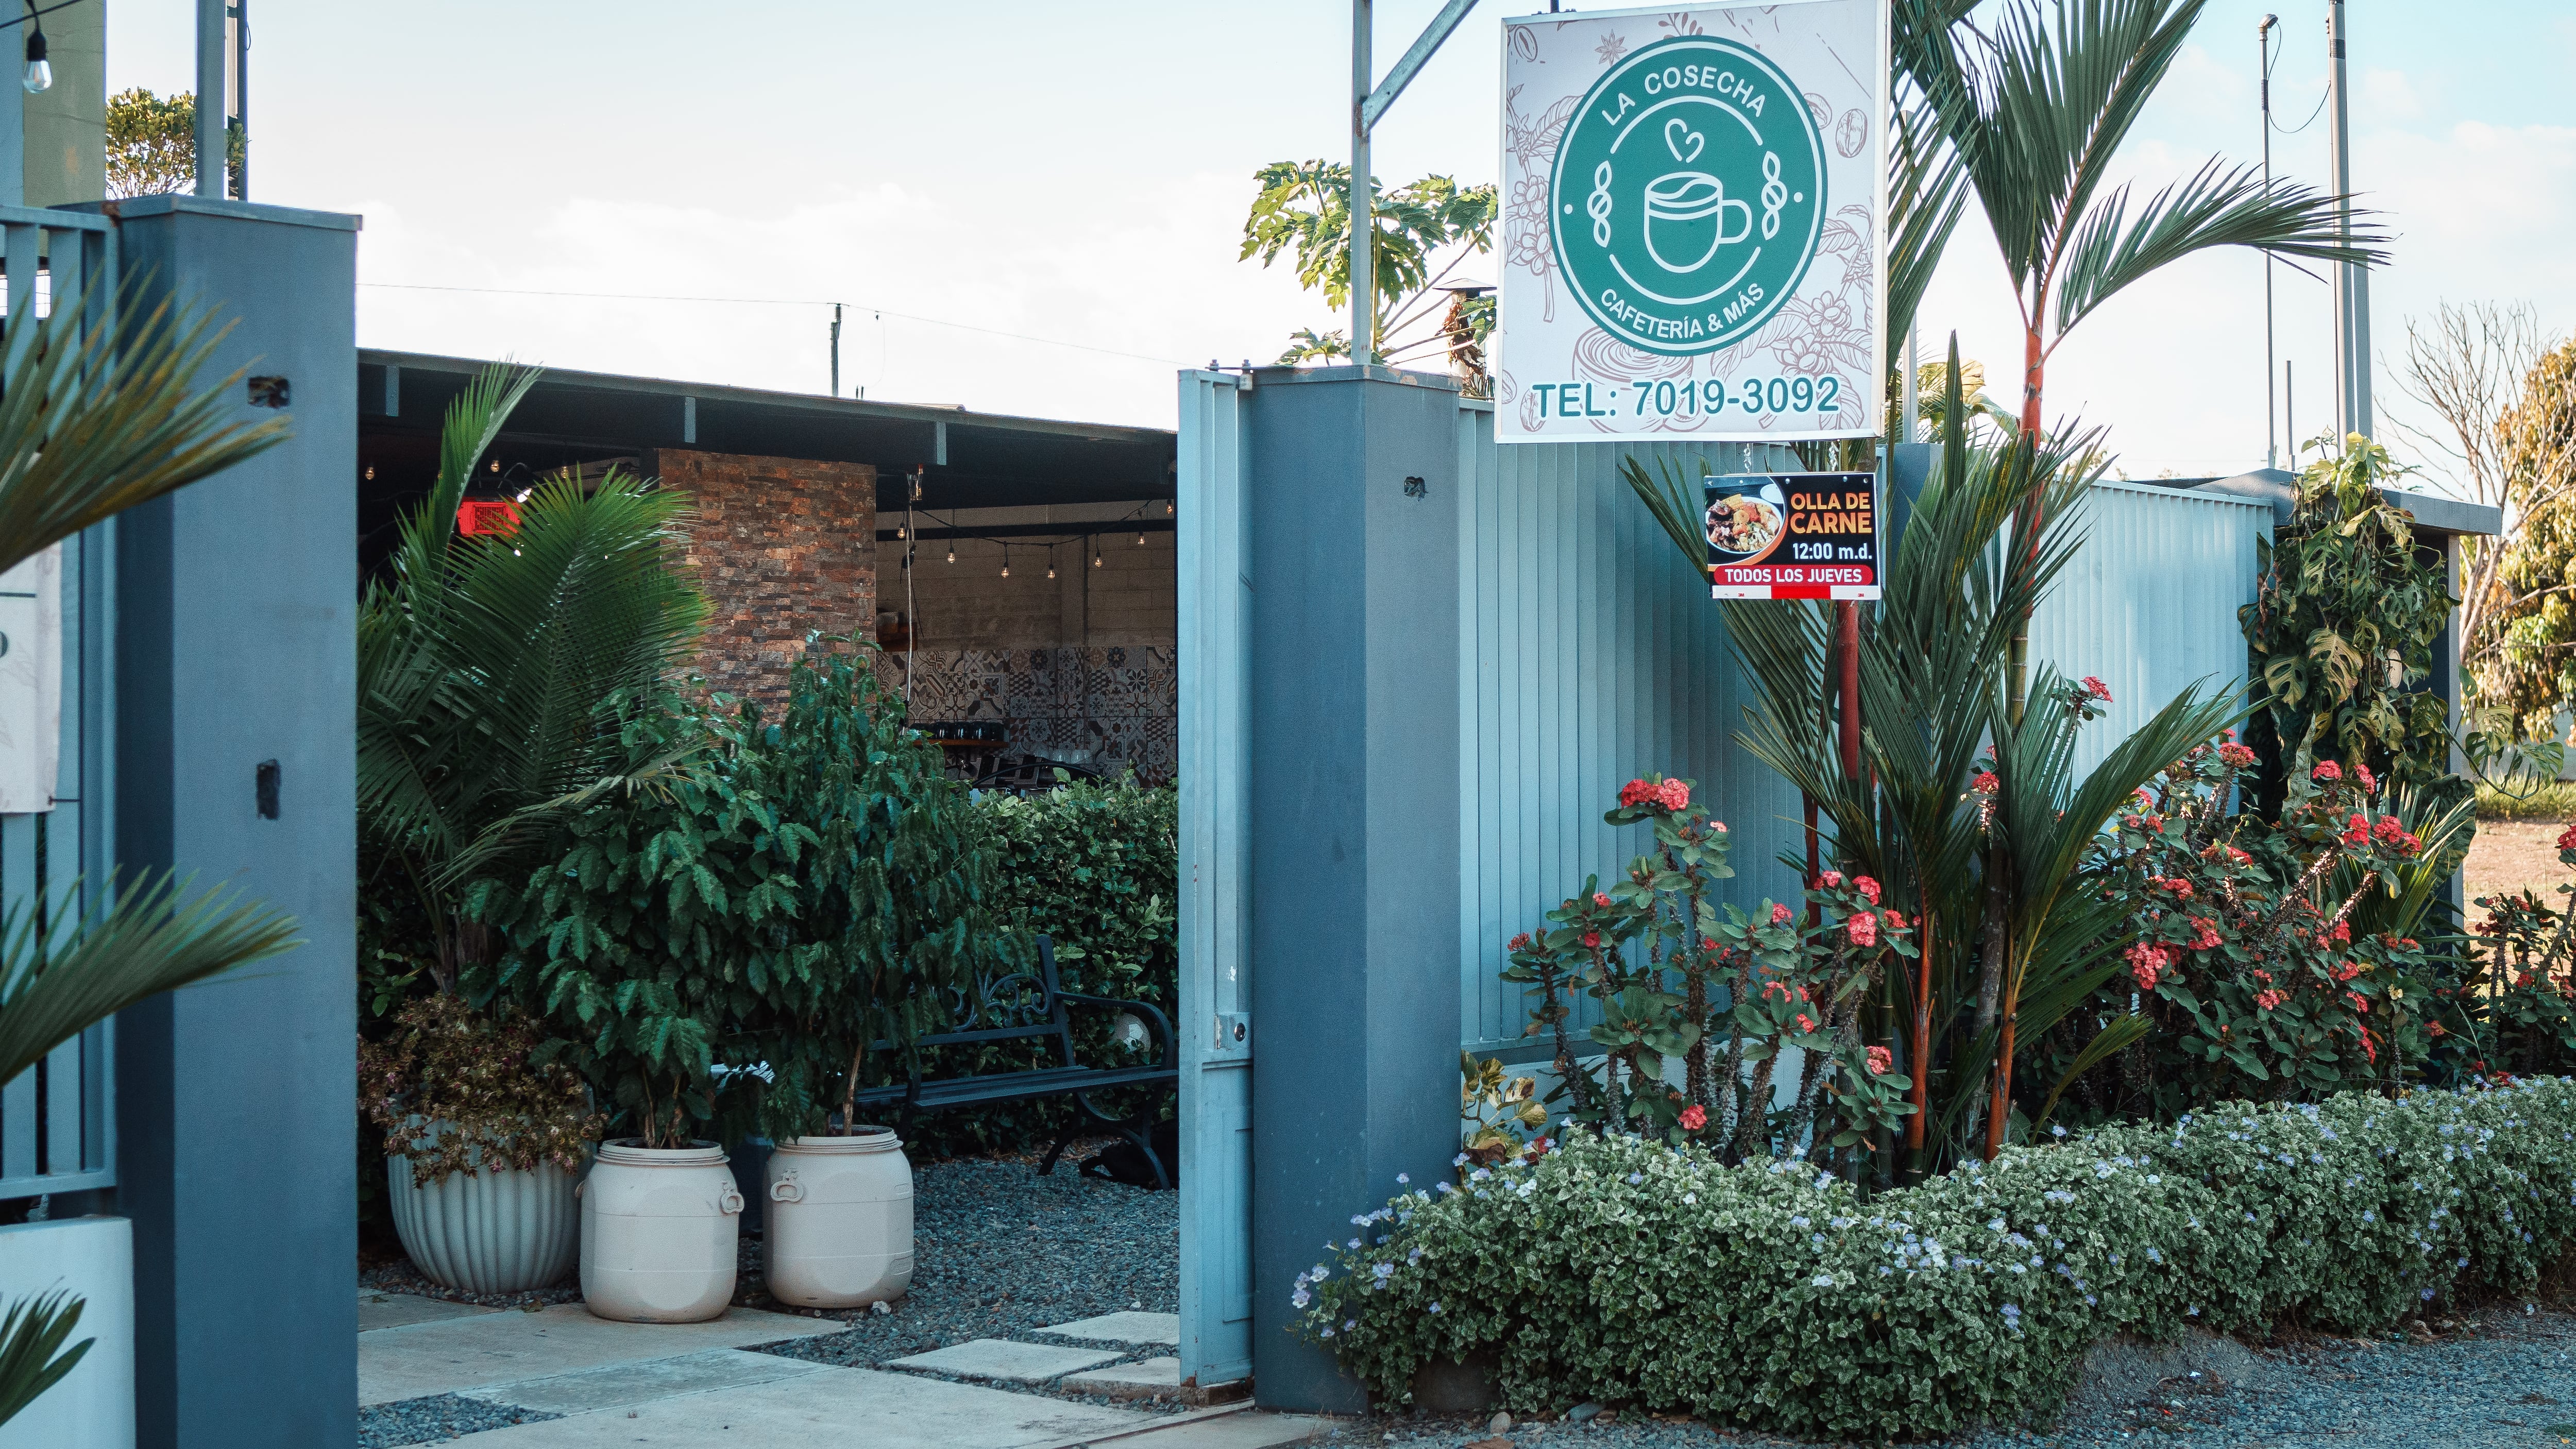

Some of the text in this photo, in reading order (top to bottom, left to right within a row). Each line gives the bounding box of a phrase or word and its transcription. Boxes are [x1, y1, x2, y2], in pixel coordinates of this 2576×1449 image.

[1602, 65, 1766, 126] LA COSECHA
[1601, 283, 1764, 339] CAFETERÍA & MÁS
[1532, 376, 1840, 418] TEL: 7019-3092
[1790, 492, 1870, 510] OLLA DE
[1790, 512, 1872, 534] CARNE
[1792, 543, 1872, 559] 12:00 m.d.
[1724, 568, 1862, 583] TODOS LOS JUEVES
